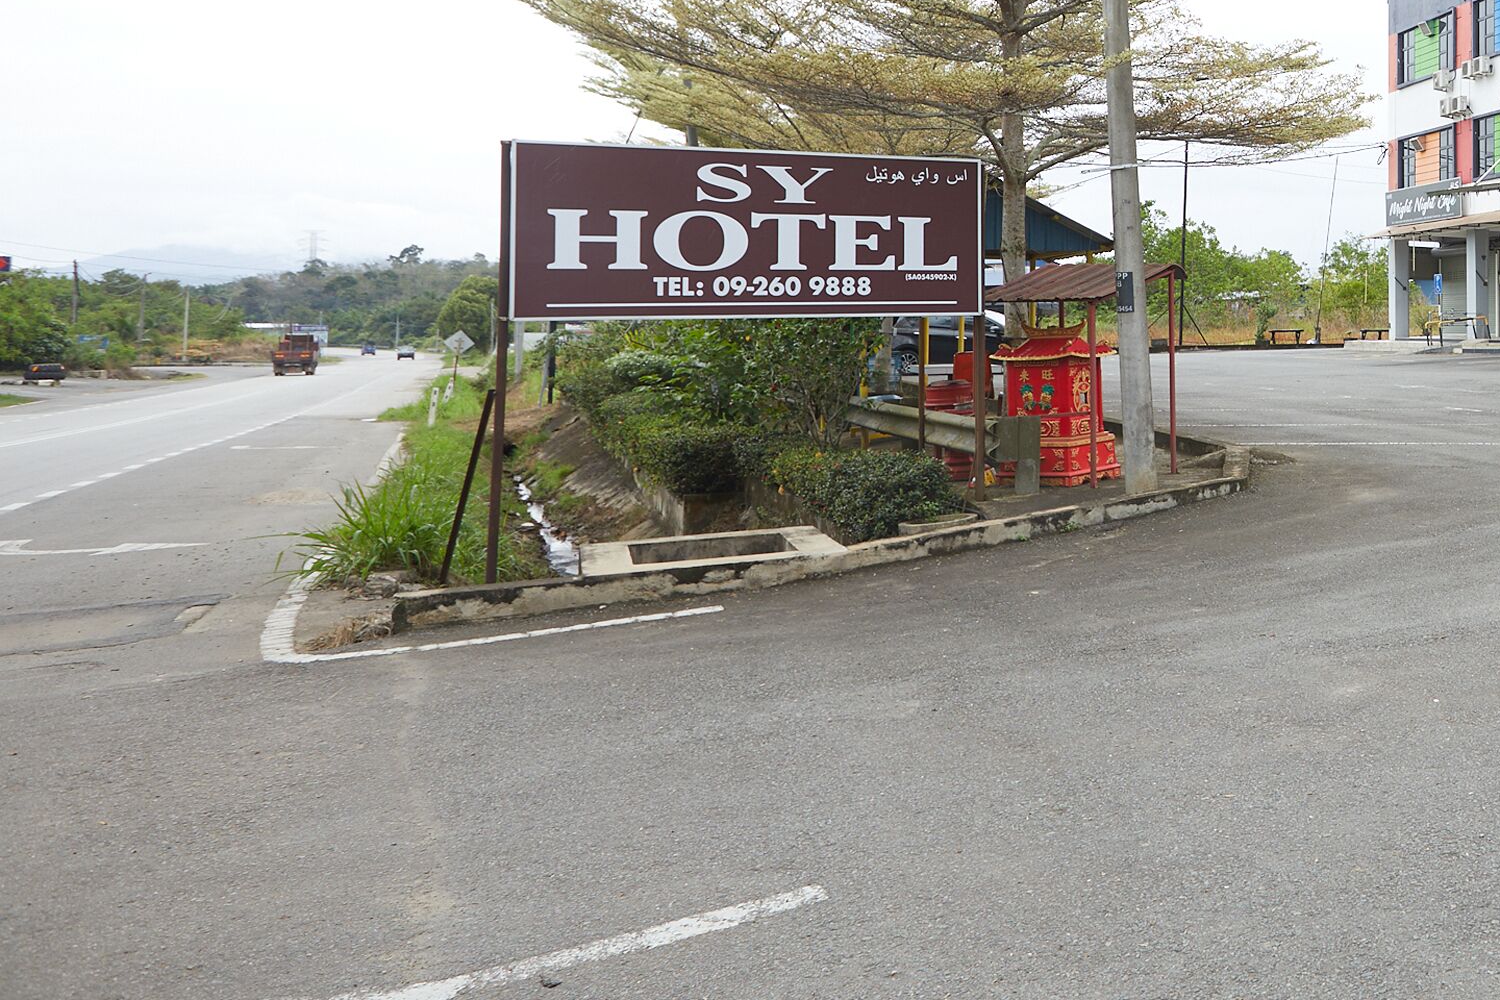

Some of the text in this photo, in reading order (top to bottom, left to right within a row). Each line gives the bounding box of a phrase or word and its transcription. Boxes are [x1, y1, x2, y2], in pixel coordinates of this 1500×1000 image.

[696, 162, 834, 205] SY
[1414, 195, 1436, 216] Night
[546, 208, 958, 272] HOTEL
[652, 275, 873, 297] TEL: 09-260 9888
